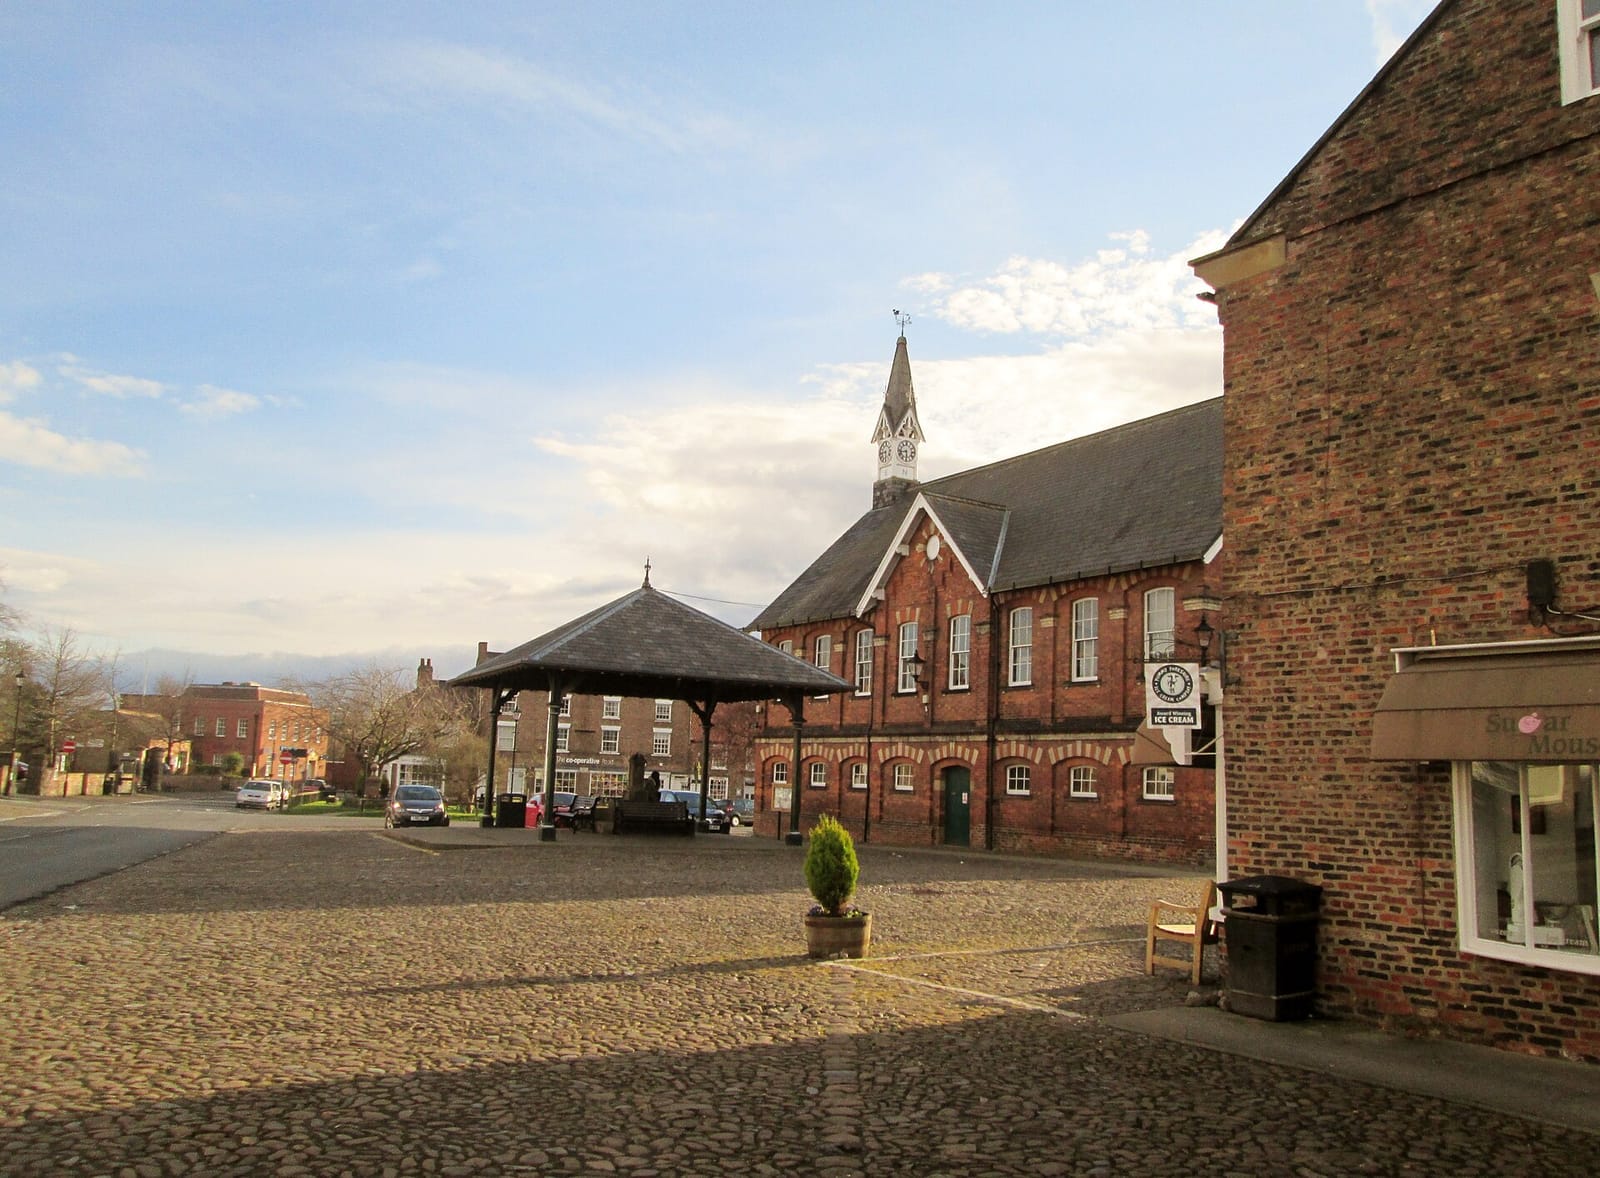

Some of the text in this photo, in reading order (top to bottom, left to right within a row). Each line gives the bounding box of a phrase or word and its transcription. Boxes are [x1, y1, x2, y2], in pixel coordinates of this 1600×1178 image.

[1154, 716, 1194, 724] ICE CREAM
[1485, 713, 1571, 734] Suar
[1528, 735, 1600, 755] Mous
